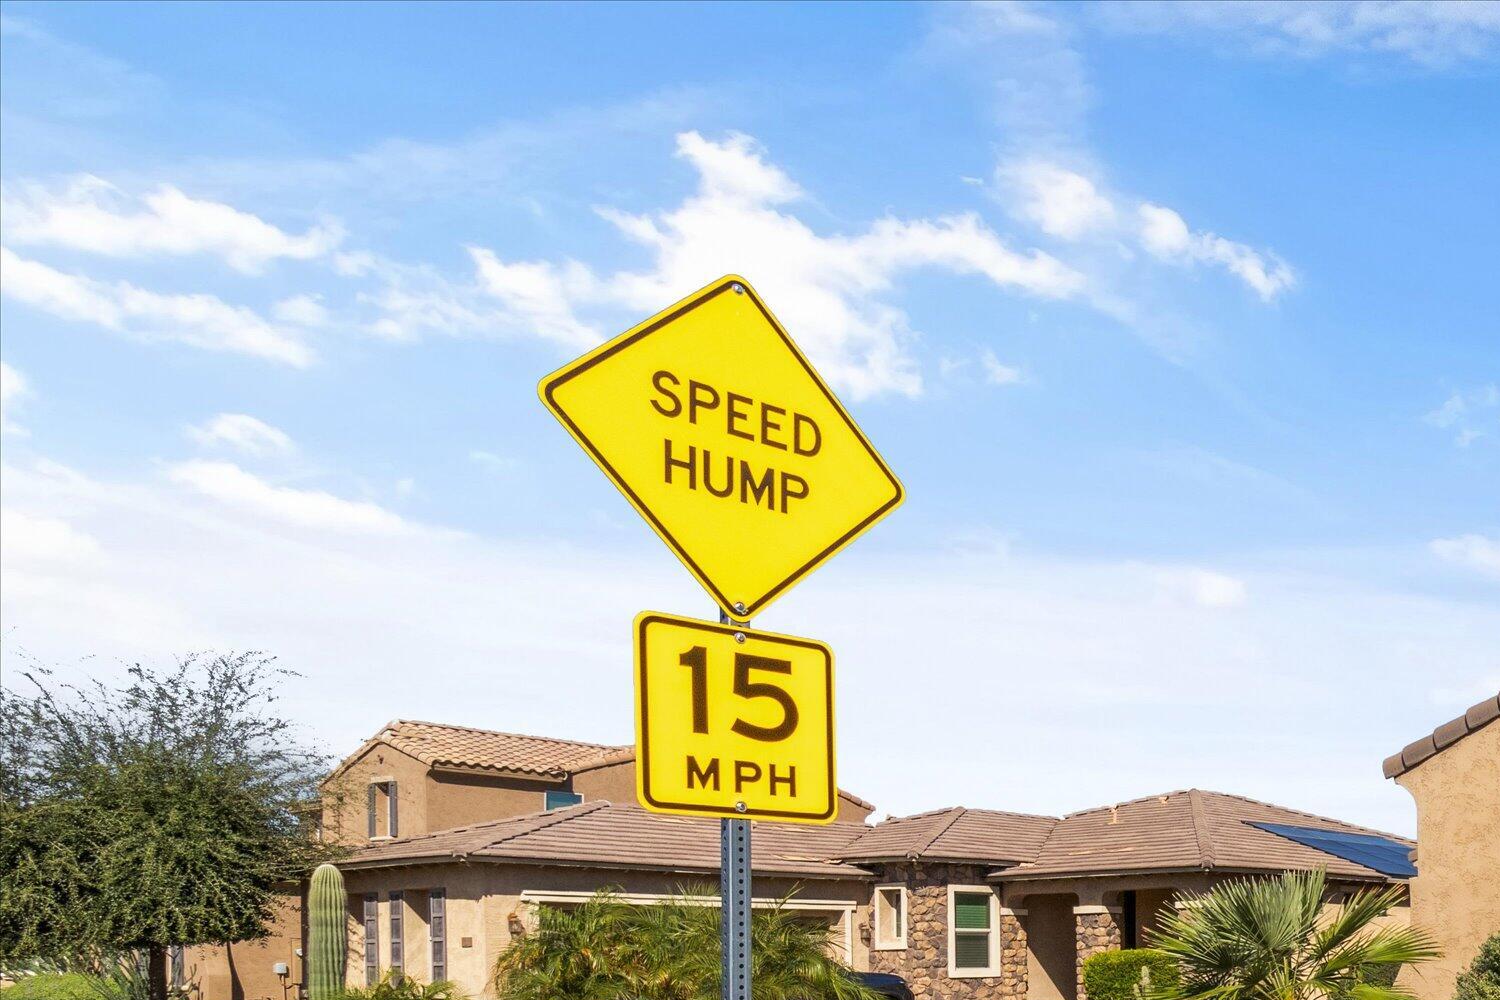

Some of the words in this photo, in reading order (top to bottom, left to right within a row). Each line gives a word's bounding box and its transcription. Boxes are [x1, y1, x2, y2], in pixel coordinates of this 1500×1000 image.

[650, 370, 822, 457] SPEED
[664, 438, 809, 514] HUMP
[679, 646, 799, 742] 15
[686, 755, 797, 798] MPH
